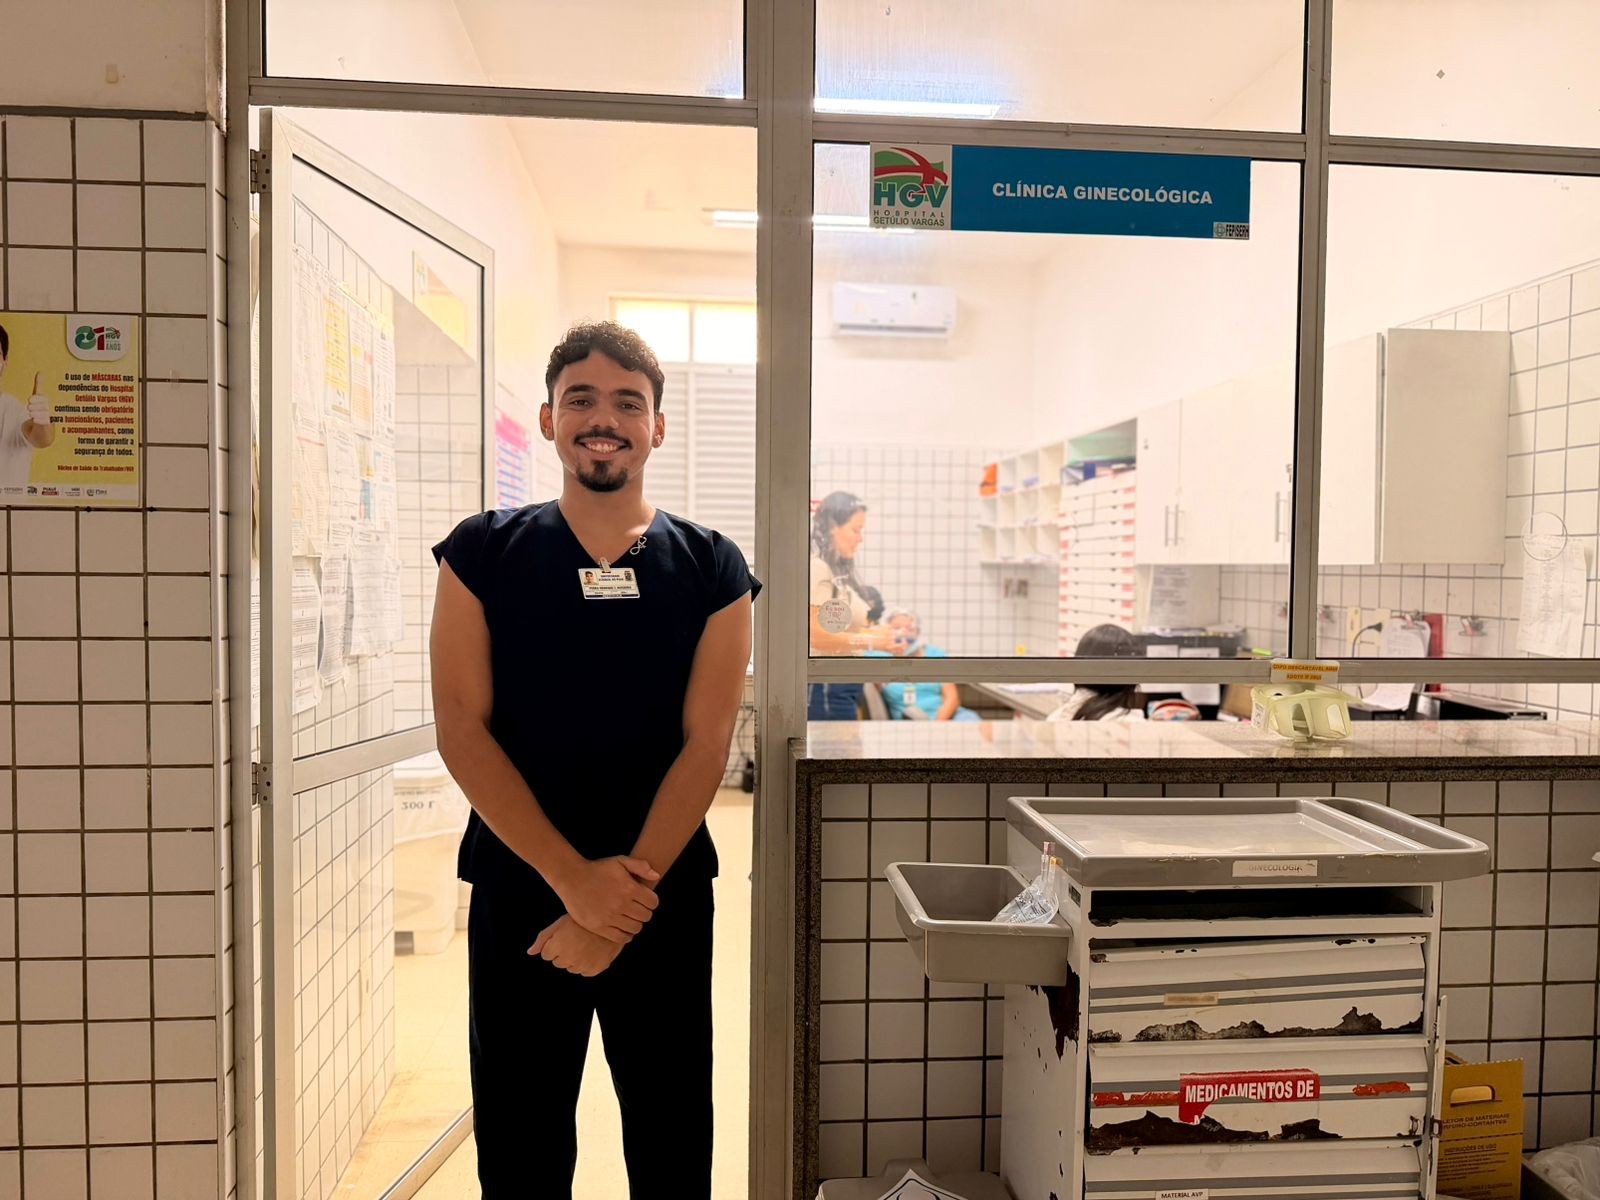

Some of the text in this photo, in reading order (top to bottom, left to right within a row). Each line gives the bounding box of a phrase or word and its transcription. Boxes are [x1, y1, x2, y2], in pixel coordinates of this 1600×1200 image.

[874, 182, 949, 208] HGV
[992, 180, 1213, 204] CLÍNICA GINECOLÓGICA
[873, 210, 945, 218] HOSPITAL
[873, 216, 945, 227] GETÚLIO VARGAS
[83, 373, 90, 381] de
[91, 372, 122, 382] MÁSCARAS
[58, 383, 134, 393] dependências do Hospital
[97, 395, 118, 403] Vargas
[54, 404, 134, 414] continua sendo obrigatório
[49, 416, 64, 424] para
[104, 416, 134, 425] pacientes
[77, 437, 95, 445] forma
[96, 437, 105, 445] de
[105, 437, 128, 446] garantir
[74, 448, 105, 457] segurança
[106, 448, 115, 456] de
[1185, 1080, 1315, 1102] MEDICAMENTOS DE
[1443, 1119, 1507, 1128] RFURO-CORTANTES
